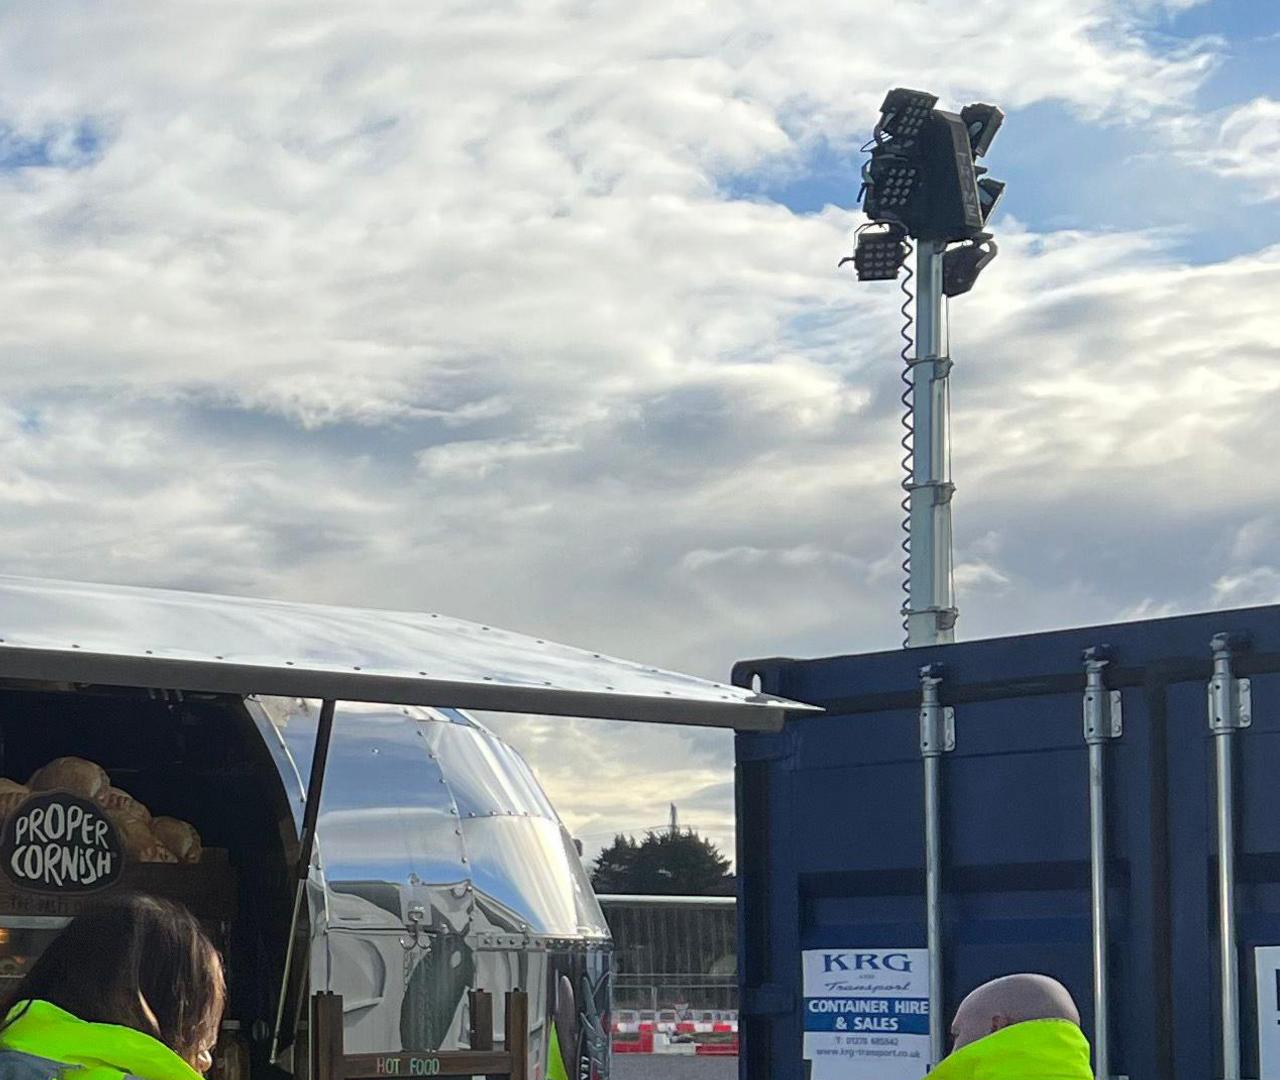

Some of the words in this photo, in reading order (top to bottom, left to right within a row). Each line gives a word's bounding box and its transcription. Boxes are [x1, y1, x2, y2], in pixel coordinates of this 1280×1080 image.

[15, 803, 109, 849] PROPER
[823, 953, 912, 972] KRG
[825, 981, 911, 992] Transport
[809, 1000, 888, 1013] CONTAINER
[895, 1001, 929, 1014] HIRE
[836, 1017, 847, 1029] &
[854, 1017, 898, 1030] SALES
[376, 1058, 400, 1074] HOT
[410, 1058, 440, 1076] FOOD
